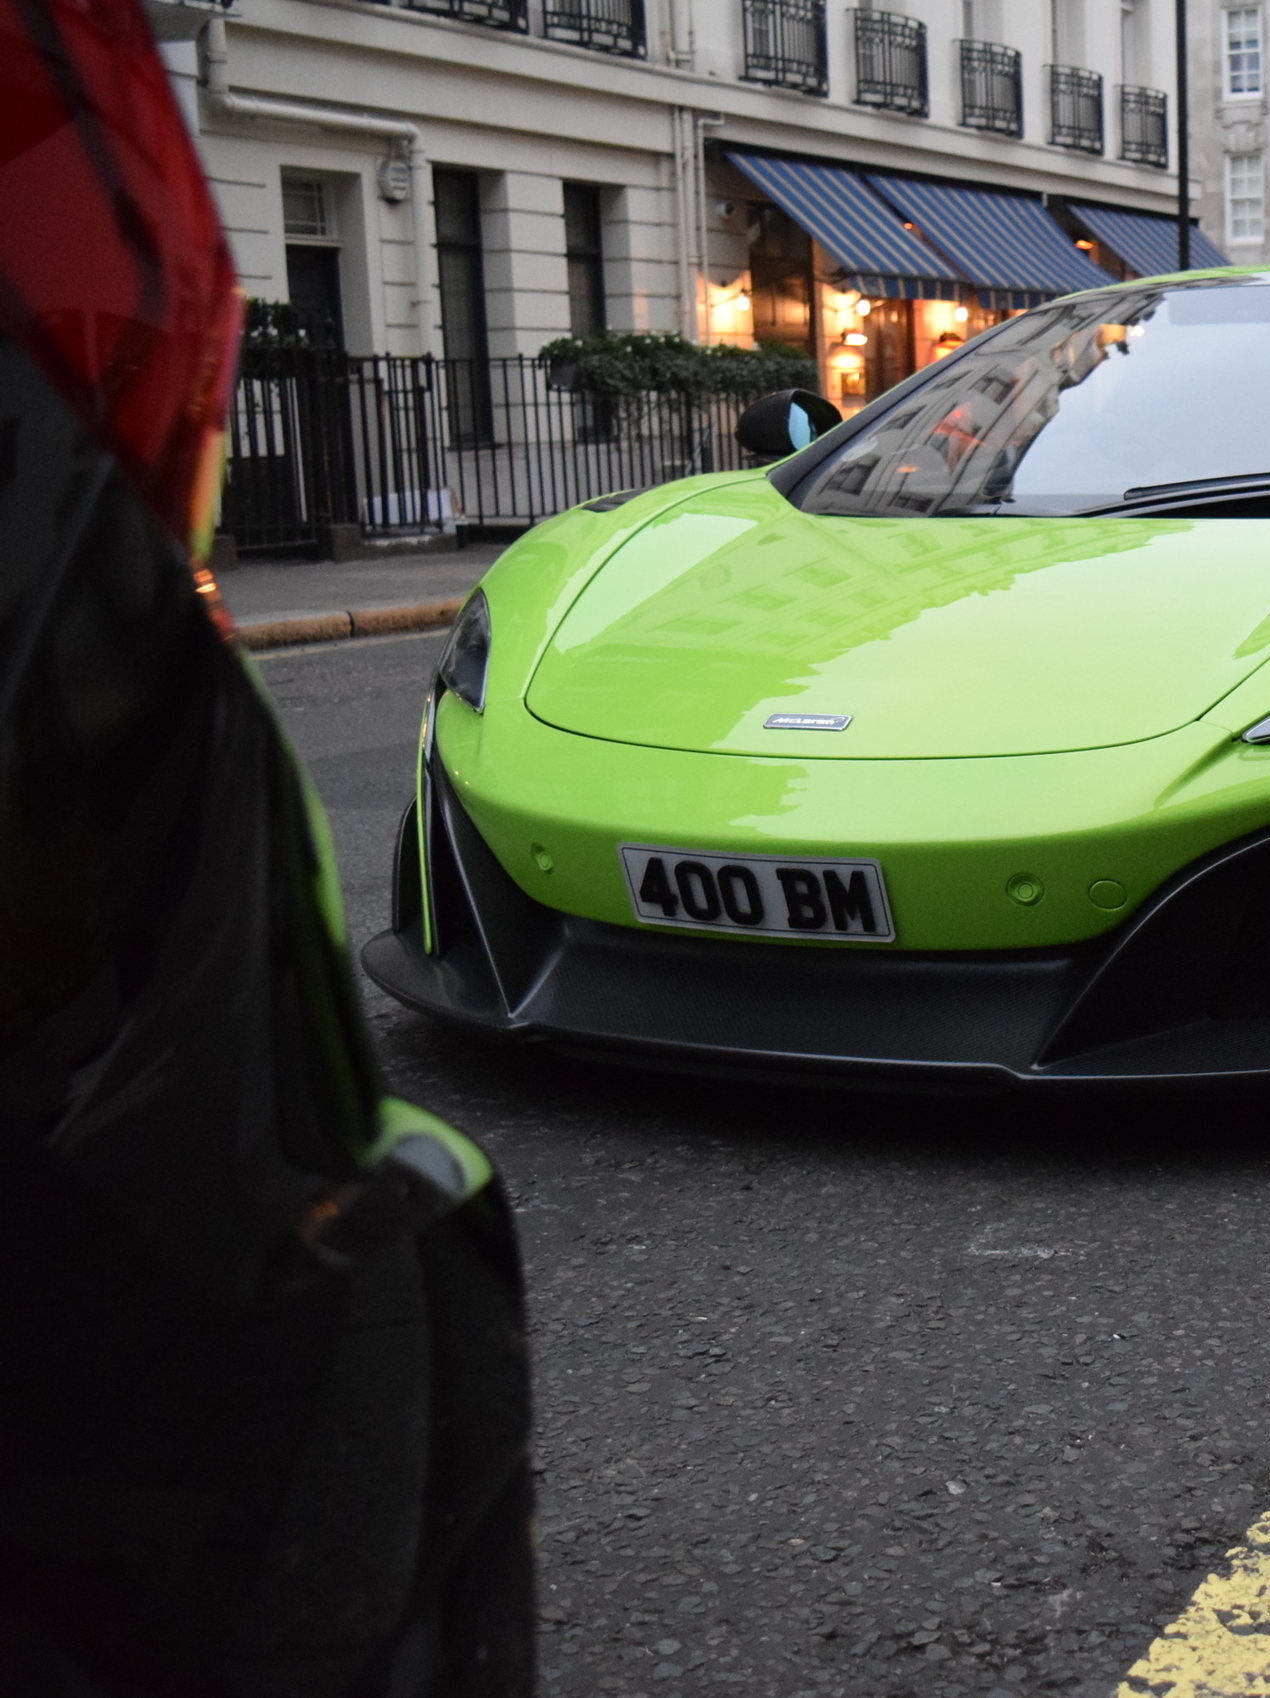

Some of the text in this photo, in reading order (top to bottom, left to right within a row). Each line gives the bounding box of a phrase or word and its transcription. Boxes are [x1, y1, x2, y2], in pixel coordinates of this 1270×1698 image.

[772, 717, 837, 725] McLaren
[639, 857, 877, 932] 400 BM
